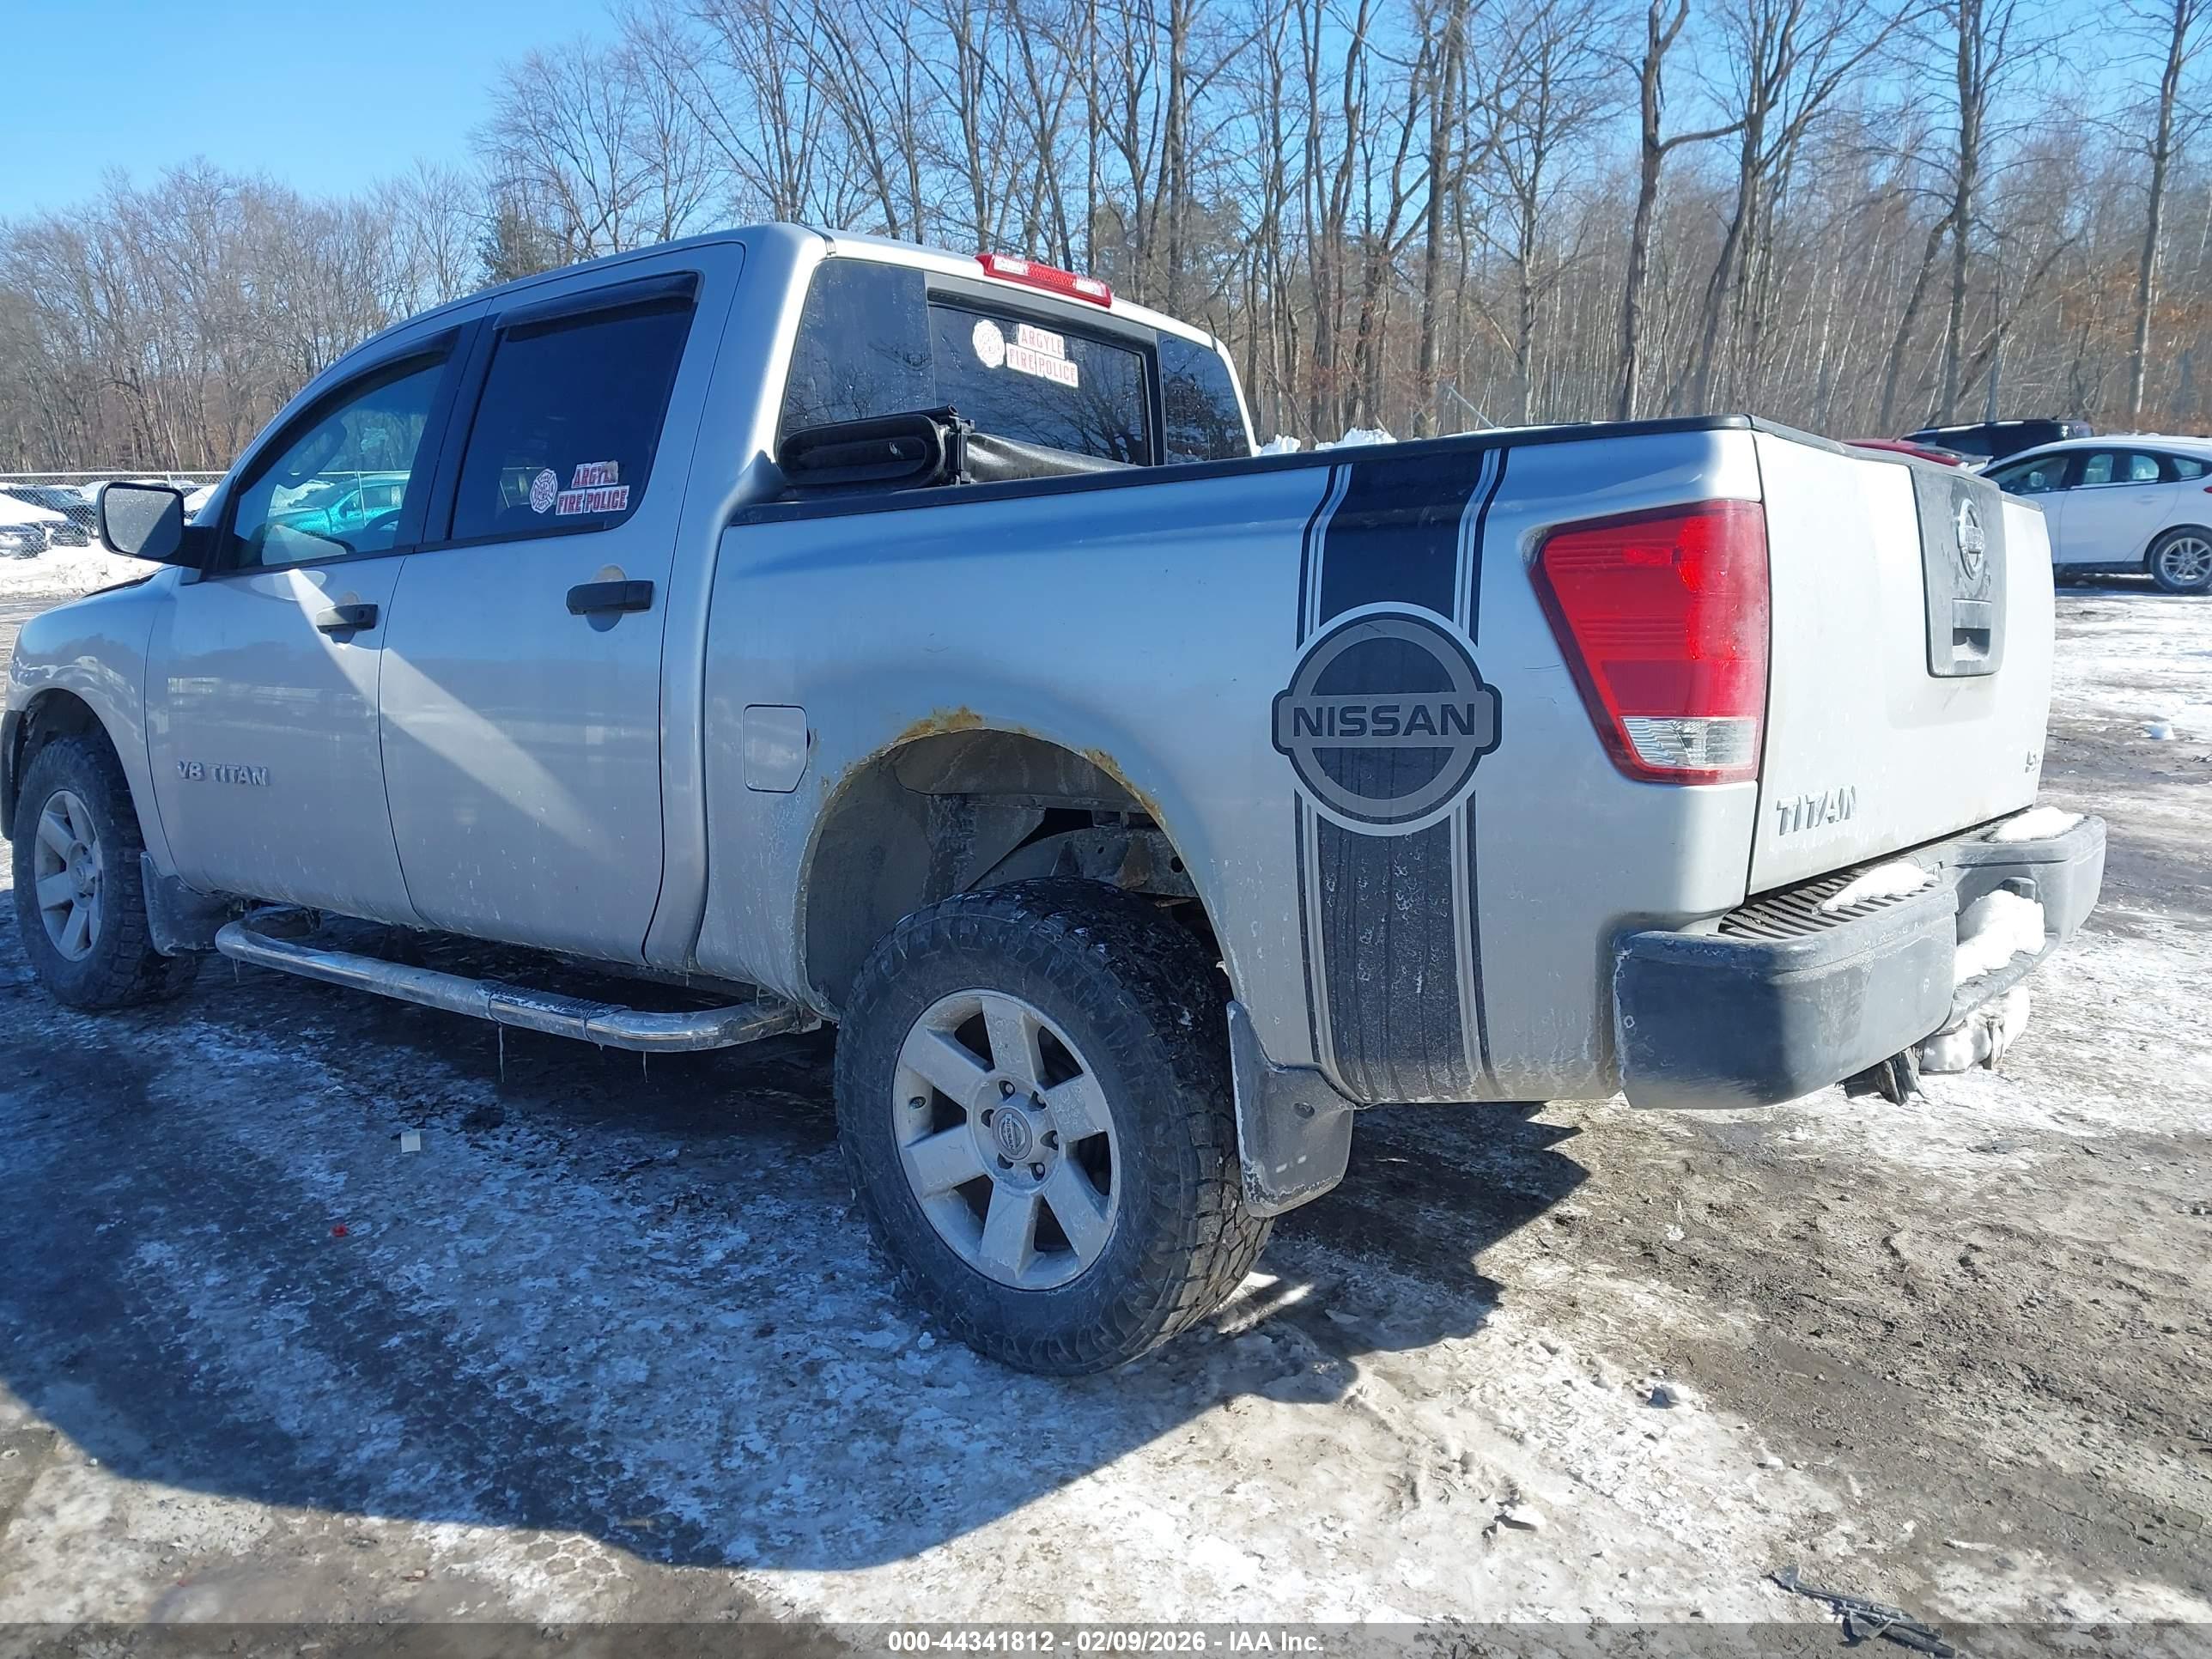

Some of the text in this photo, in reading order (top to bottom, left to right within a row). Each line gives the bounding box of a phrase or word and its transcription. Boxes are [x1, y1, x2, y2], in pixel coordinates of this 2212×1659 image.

[1021, 329, 1062, 354] ARGYLE
[1009, 349, 1076, 383] FIRE POLICE
[556, 488, 629, 514] FIRE POLICE
[1292, 702, 1476, 738] NISSAN
[207, 762, 270, 787] TITAN
[1775, 784, 1856, 837] TITAN
